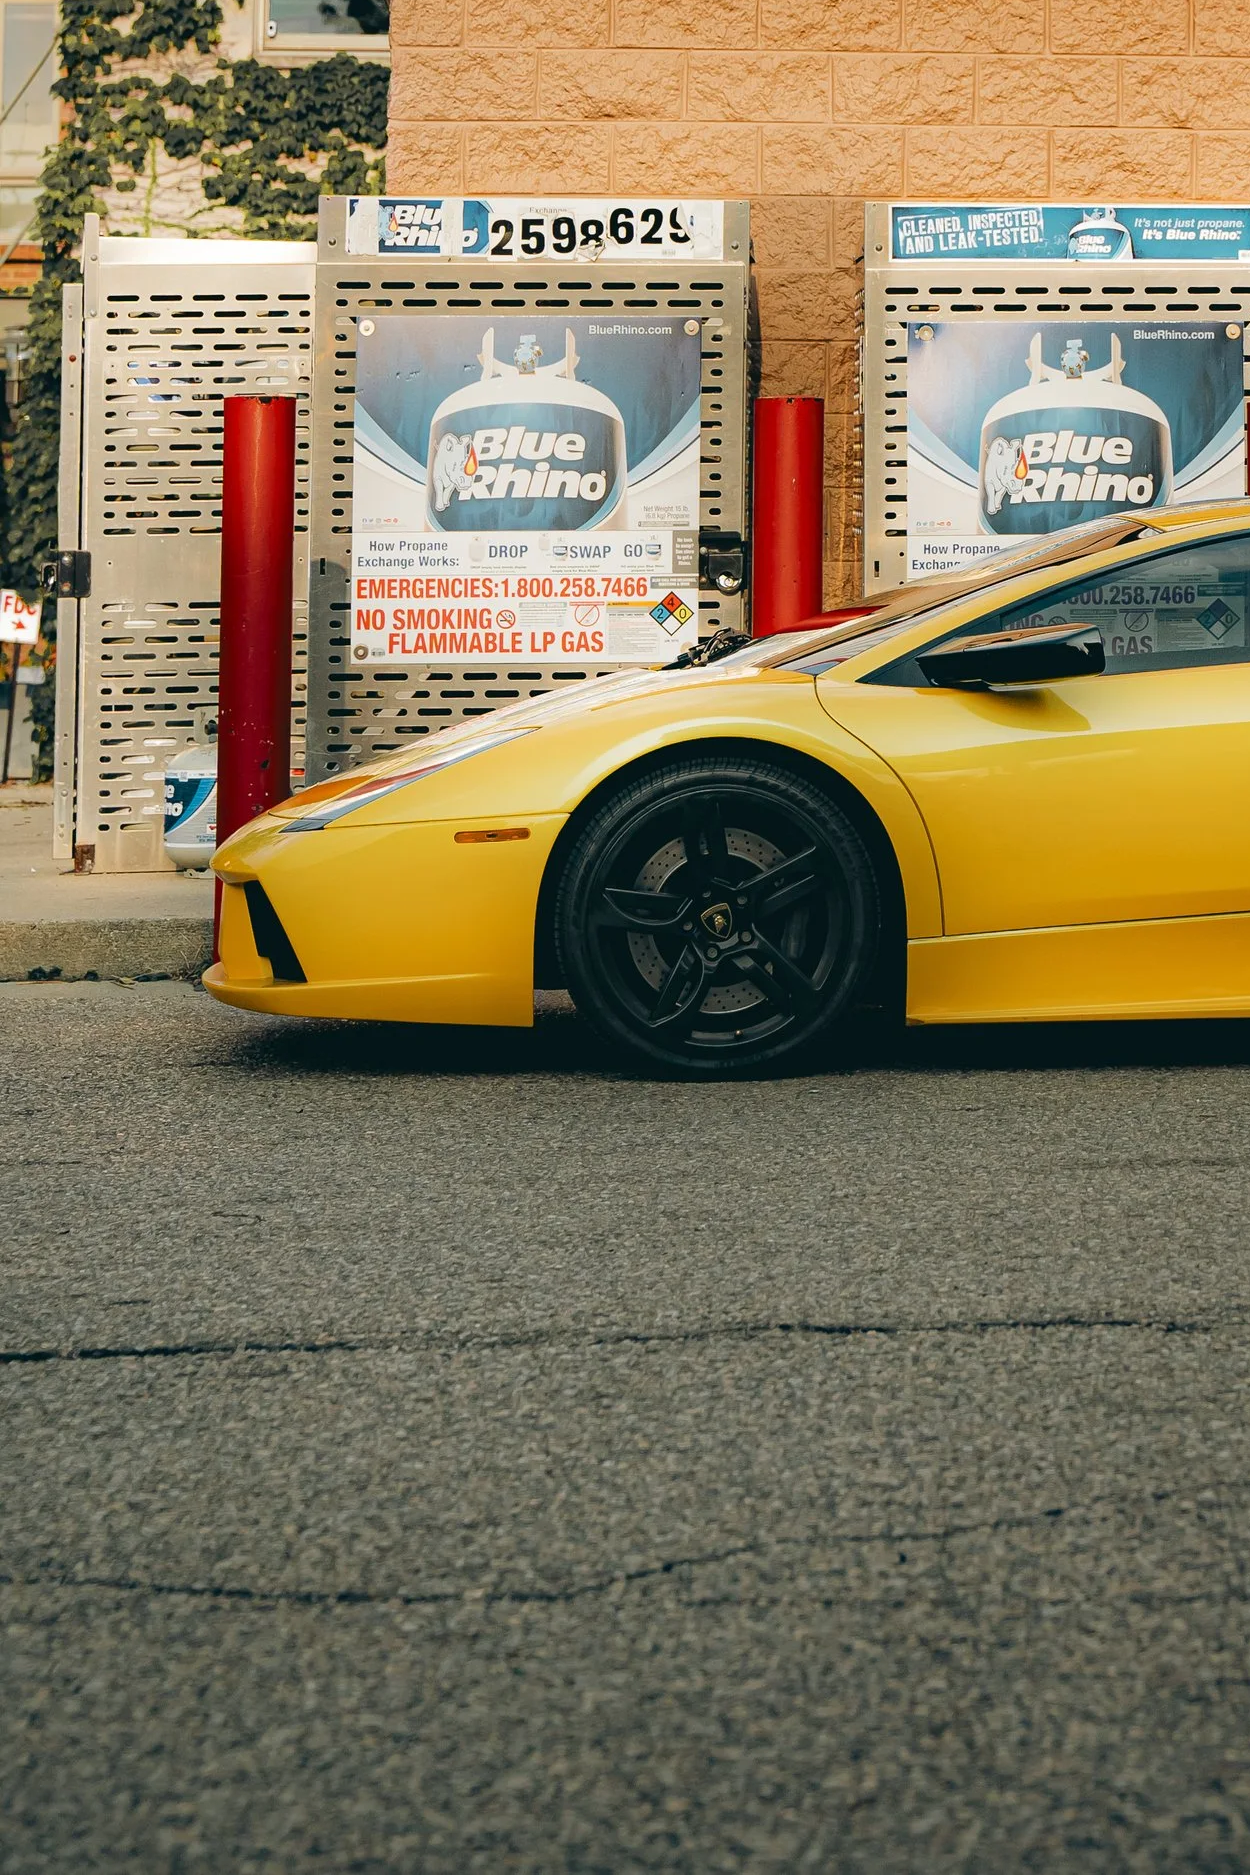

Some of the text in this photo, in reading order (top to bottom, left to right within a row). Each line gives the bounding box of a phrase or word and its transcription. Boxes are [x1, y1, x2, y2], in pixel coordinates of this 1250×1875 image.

[394, 205, 442, 225] Blu
[1134, 218, 1151, 228] It's
[1153, 219, 1172, 228] not
[1172, 219, 1196, 230] just
[1079, 234, 1105, 245] Blue
[1142, 230, 1162, 240] It's
[1166, 230, 1196, 240] Blue
[905, 235, 934, 255] AND
[588, 324, 673, 335] BlueRhino.com
[1133, 329, 1215, 340] BlueRhino.com
[472, 425, 587, 462] Blue
[1022, 429, 1134, 465] Blue
[458, 462, 605, 502] Rhino
[1010, 465, 1153, 505] Rhino
[667, 512, 690, 521] Propane
[369, 540, 448, 553] How Propane
[488, 545, 528, 559] DROP
[569, 545, 612, 559] SWAP
[624, 544, 643, 558] GO
[923, 543, 948, 555] How
[357, 556, 460, 569] Exchange Works:
[667, 598, 674, 607] 4
[356, 608, 492, 631] NO SMOKING
[656, 608, 687, 619] 2 0
[1225, 613, 1234, 625] 0
[388, 632, 523, 654] FLAMMABLE
[530, 631, 556, 653] LP
[561, 631, 604, 654] GAS
[1111, 635, 1153, 656] GAS
